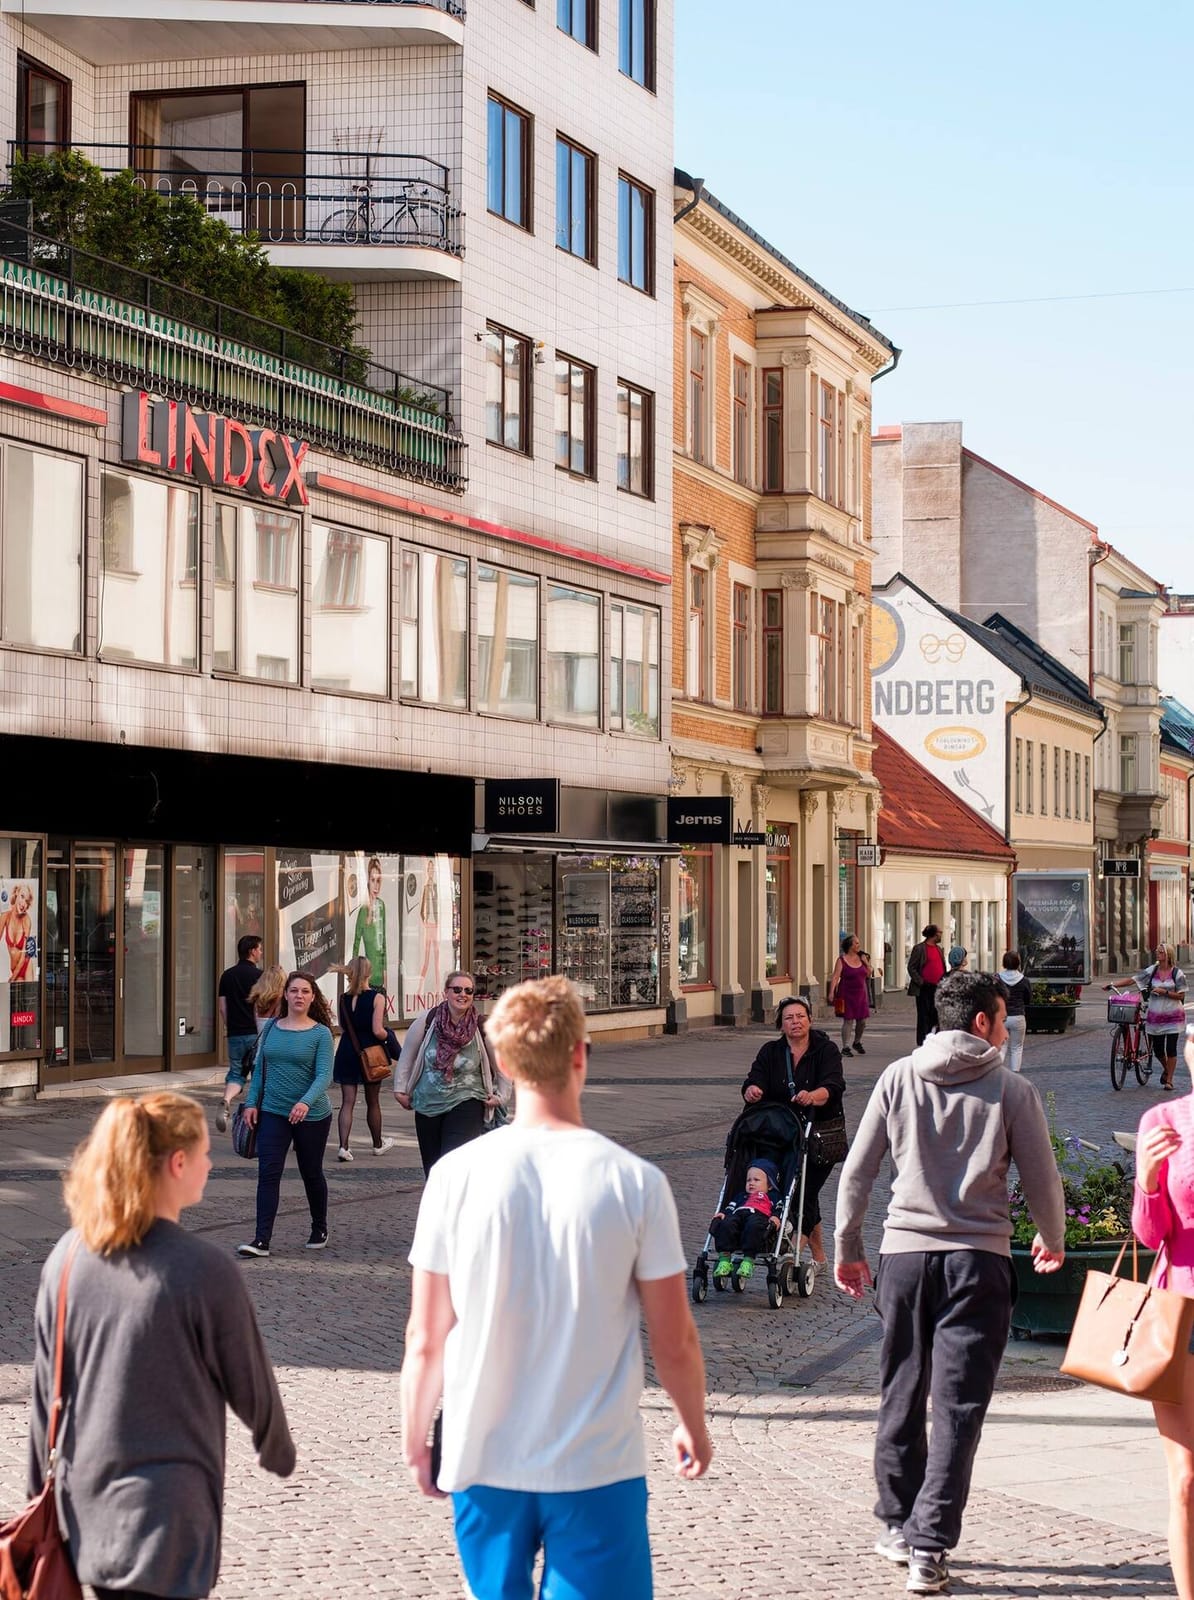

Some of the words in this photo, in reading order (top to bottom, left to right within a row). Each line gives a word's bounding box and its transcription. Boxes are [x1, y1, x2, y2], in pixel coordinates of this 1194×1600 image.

[130, 391, 309, 505] LINDEX
[499, 796, 543, 806] NILSON
[498, 806, 543, 816] SHOES
[675, 815, 722, 825] Jerns
[14, 1015, 33, 1025] LINDEX
